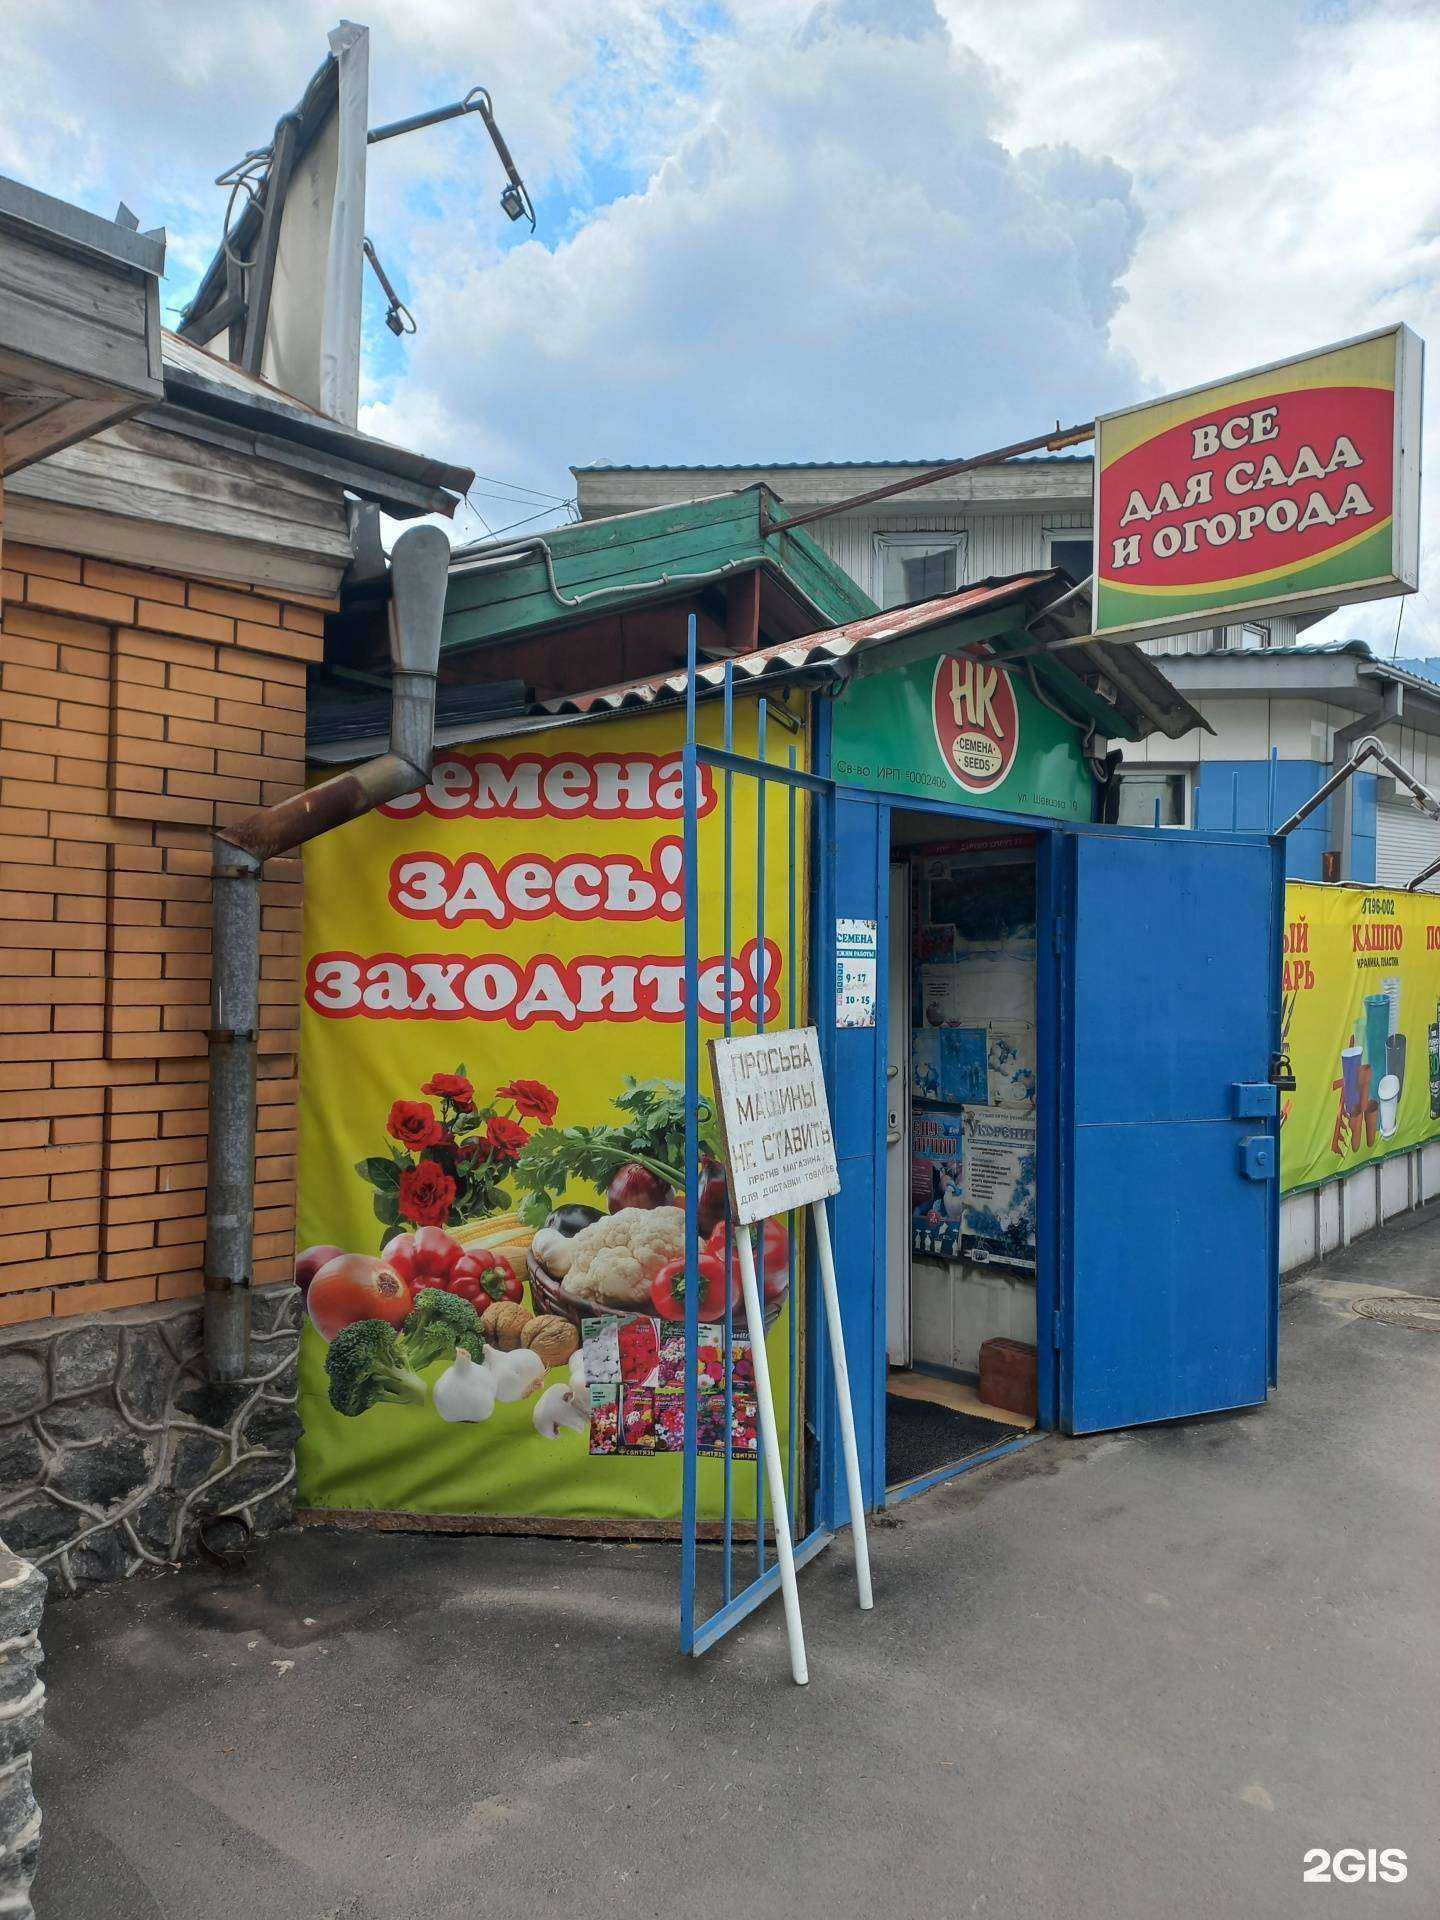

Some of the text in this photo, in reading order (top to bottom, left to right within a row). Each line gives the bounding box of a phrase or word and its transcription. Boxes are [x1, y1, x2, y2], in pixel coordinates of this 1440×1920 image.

[1192, 407, 1279, 460] ВСЕ
[1120, 436, 1364, 527] ДЛЯ САДА
[1111, 483, 1375, 568] И ОГОРОДА
[958, 737, 994, 755] СЕМЕНА
[963, 756, 992, 772] SEEDS
[386, 760, 704, 811] емена
[836, 933, 874, 944] СЕМЕНА
[1352, 924, 1403, 952] КАШПО
[730, 1043, 813, 1081] ПРОСЬБА
[736, 1081, 818, 1125] МАШИНЫ
[761, 1120, 831, 1162] СТАВИТЬ
[741, 1190, 760, 1206] ДЛЯ
